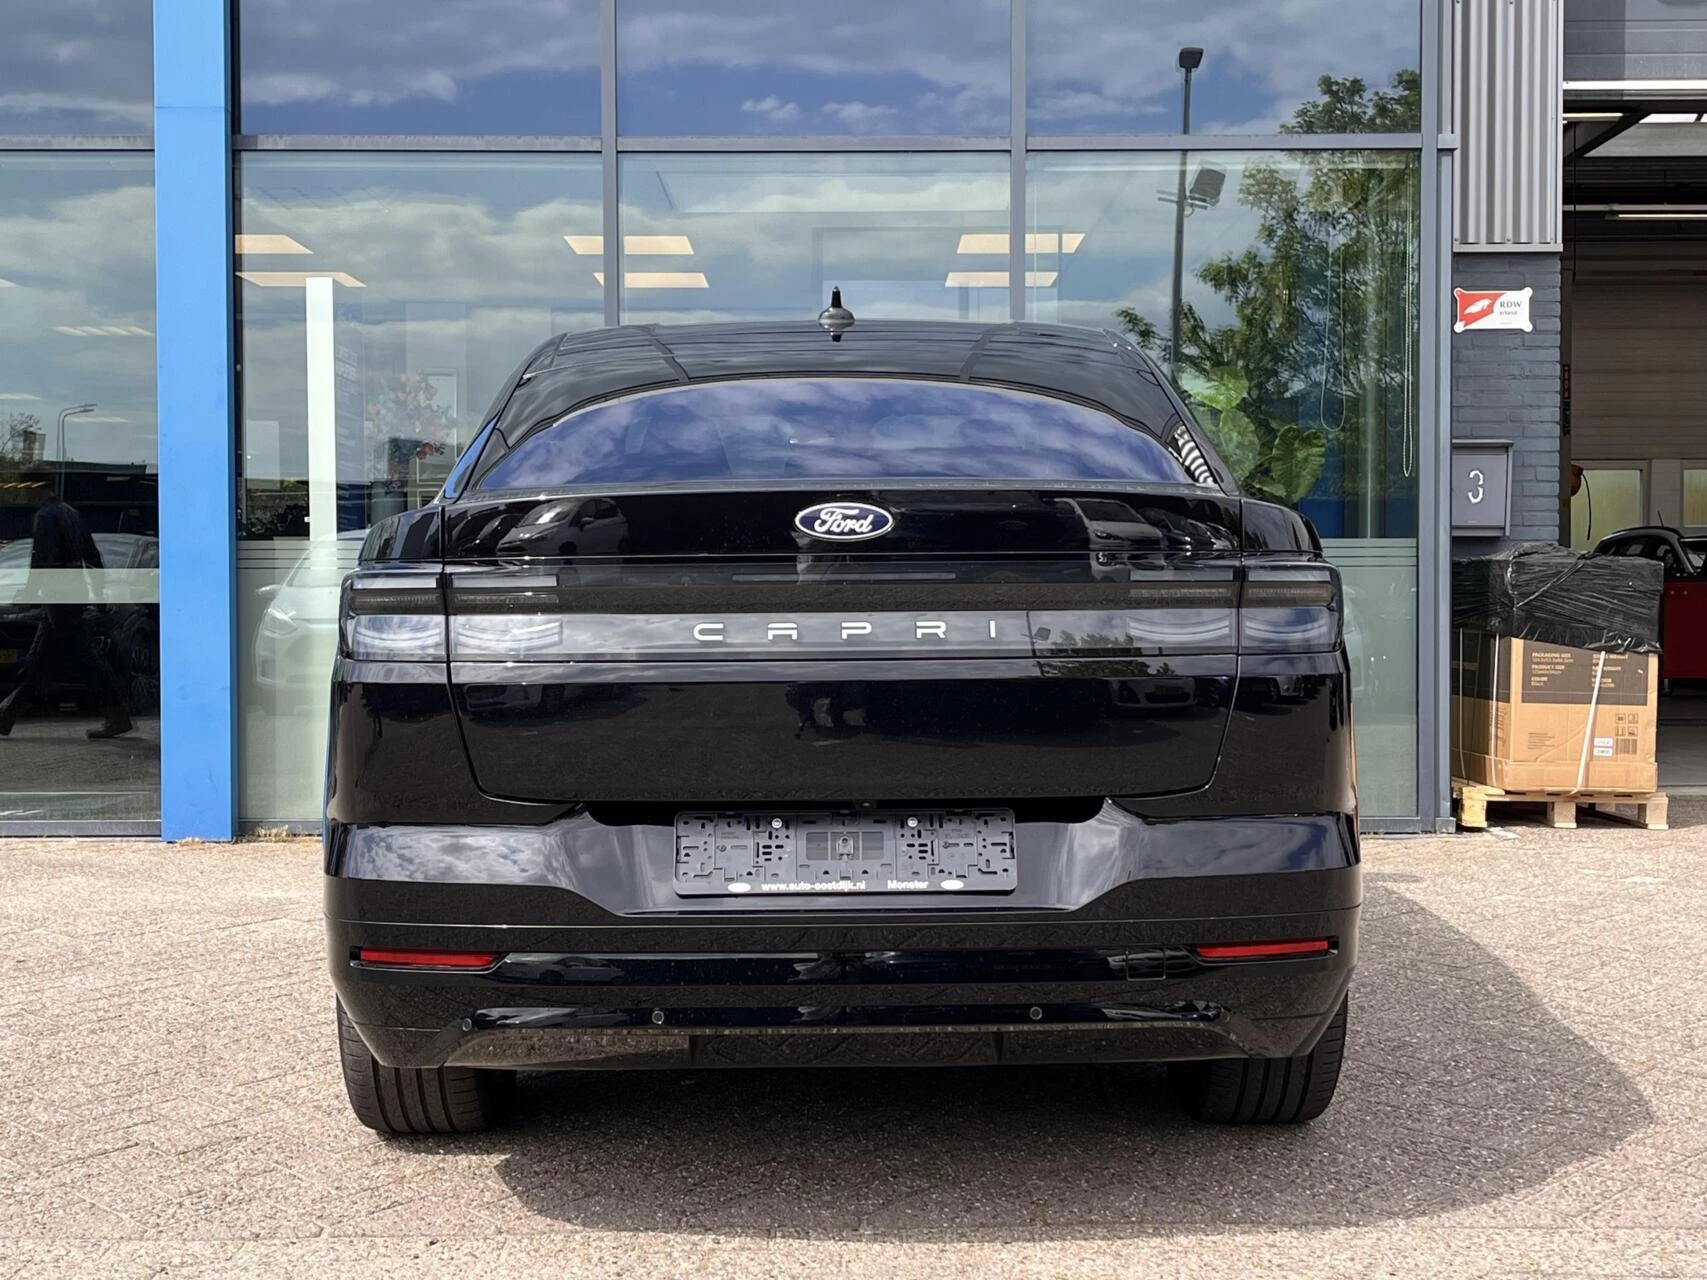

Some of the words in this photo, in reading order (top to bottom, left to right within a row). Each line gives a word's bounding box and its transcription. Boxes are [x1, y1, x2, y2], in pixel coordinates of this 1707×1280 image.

[1500, 300, 1521, 308] RDW
[1468, 470, 1483, 504] 3
[814, 508, 874, 533] Ford
[693, 621, 996, 641] CAPRI
[761, 880, 866, 892] www.auto-oostdijk.nl
[887, 879, 928, 889] Monster
